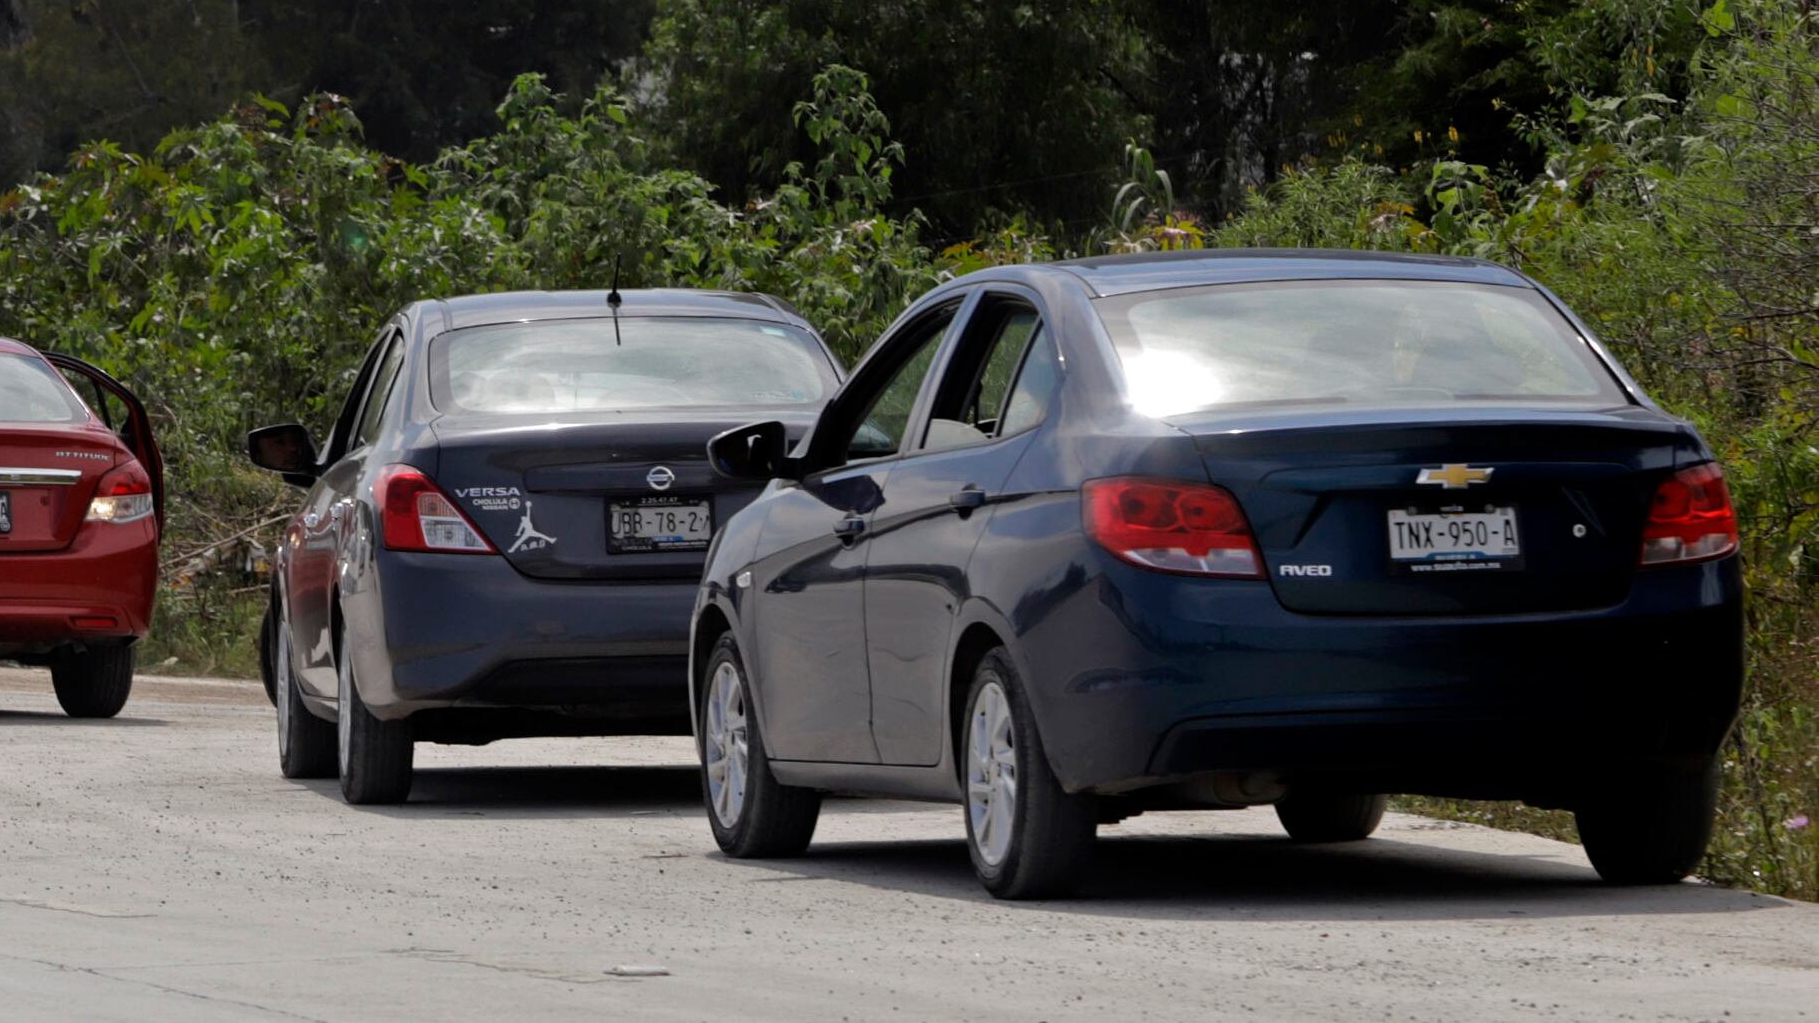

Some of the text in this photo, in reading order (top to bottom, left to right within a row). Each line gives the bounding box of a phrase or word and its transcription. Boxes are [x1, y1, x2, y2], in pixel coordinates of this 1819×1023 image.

[454, 486, 521, 497] VERSA
[473, 498, 508, 506] CHOLULA
[611, 511, 710, 535] UBB-78-2
[1393, 519, 1517, 549] TNX-950-A
[1279, 564, 1331, 576] AVEO
